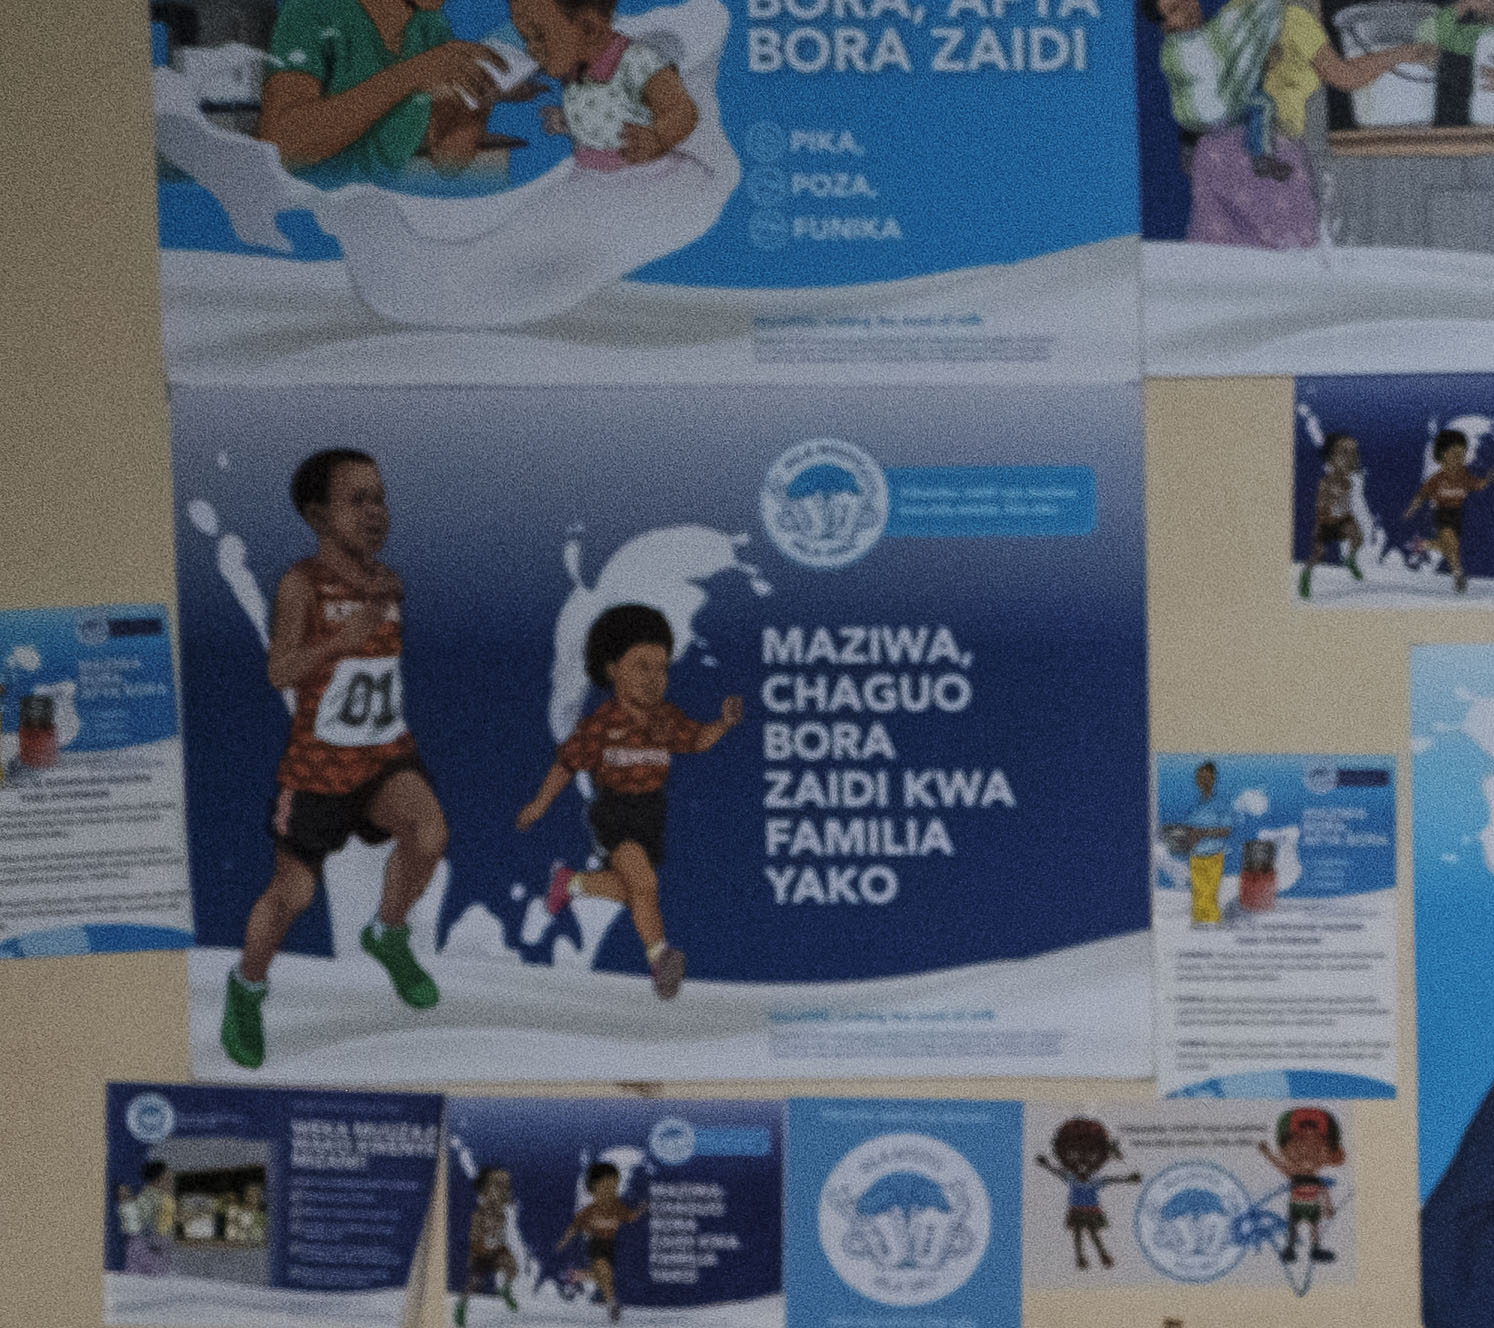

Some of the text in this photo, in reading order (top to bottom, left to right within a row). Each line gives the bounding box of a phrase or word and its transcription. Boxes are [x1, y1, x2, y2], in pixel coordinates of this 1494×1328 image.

[747, 27, 1087, 74] BORA ZAIDI
[789, 130, 866, 157] PIKA,
[790, 173, 878, 199] POZA,
[790, 216, 903, 241] FUNIKA
[761, 627, 973, 668] MAZIWA,
[338, 671, 397, 728] 01
[762, 674, 971, 713] CHAGUO
[763, 721, 895, 761] BORA
[764, 770, 1016, 808] ZAIDI KWA
[765, 818, 954, 857] FAMILIA
[765, 865, 899, 905] YAKO
